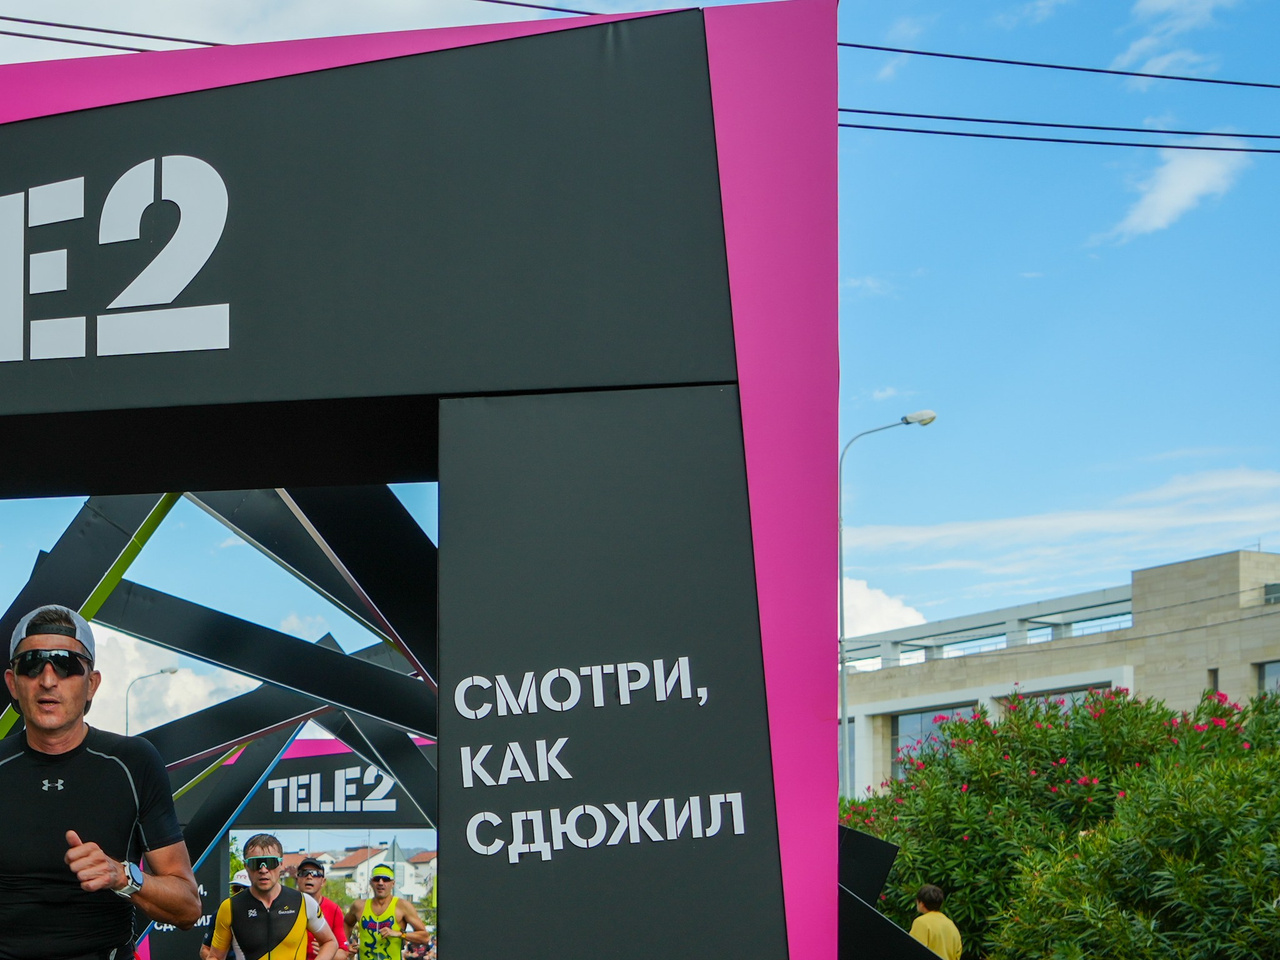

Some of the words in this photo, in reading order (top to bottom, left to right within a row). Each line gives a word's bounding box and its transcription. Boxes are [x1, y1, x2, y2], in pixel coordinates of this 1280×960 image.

[454, 656, 708, 720] СМОТРИ,
[267, 764, 397, 813] TELE2
[460, 737, 573, 788] КАК
[466, 792, 745, 864] СДЮЖИЛ
